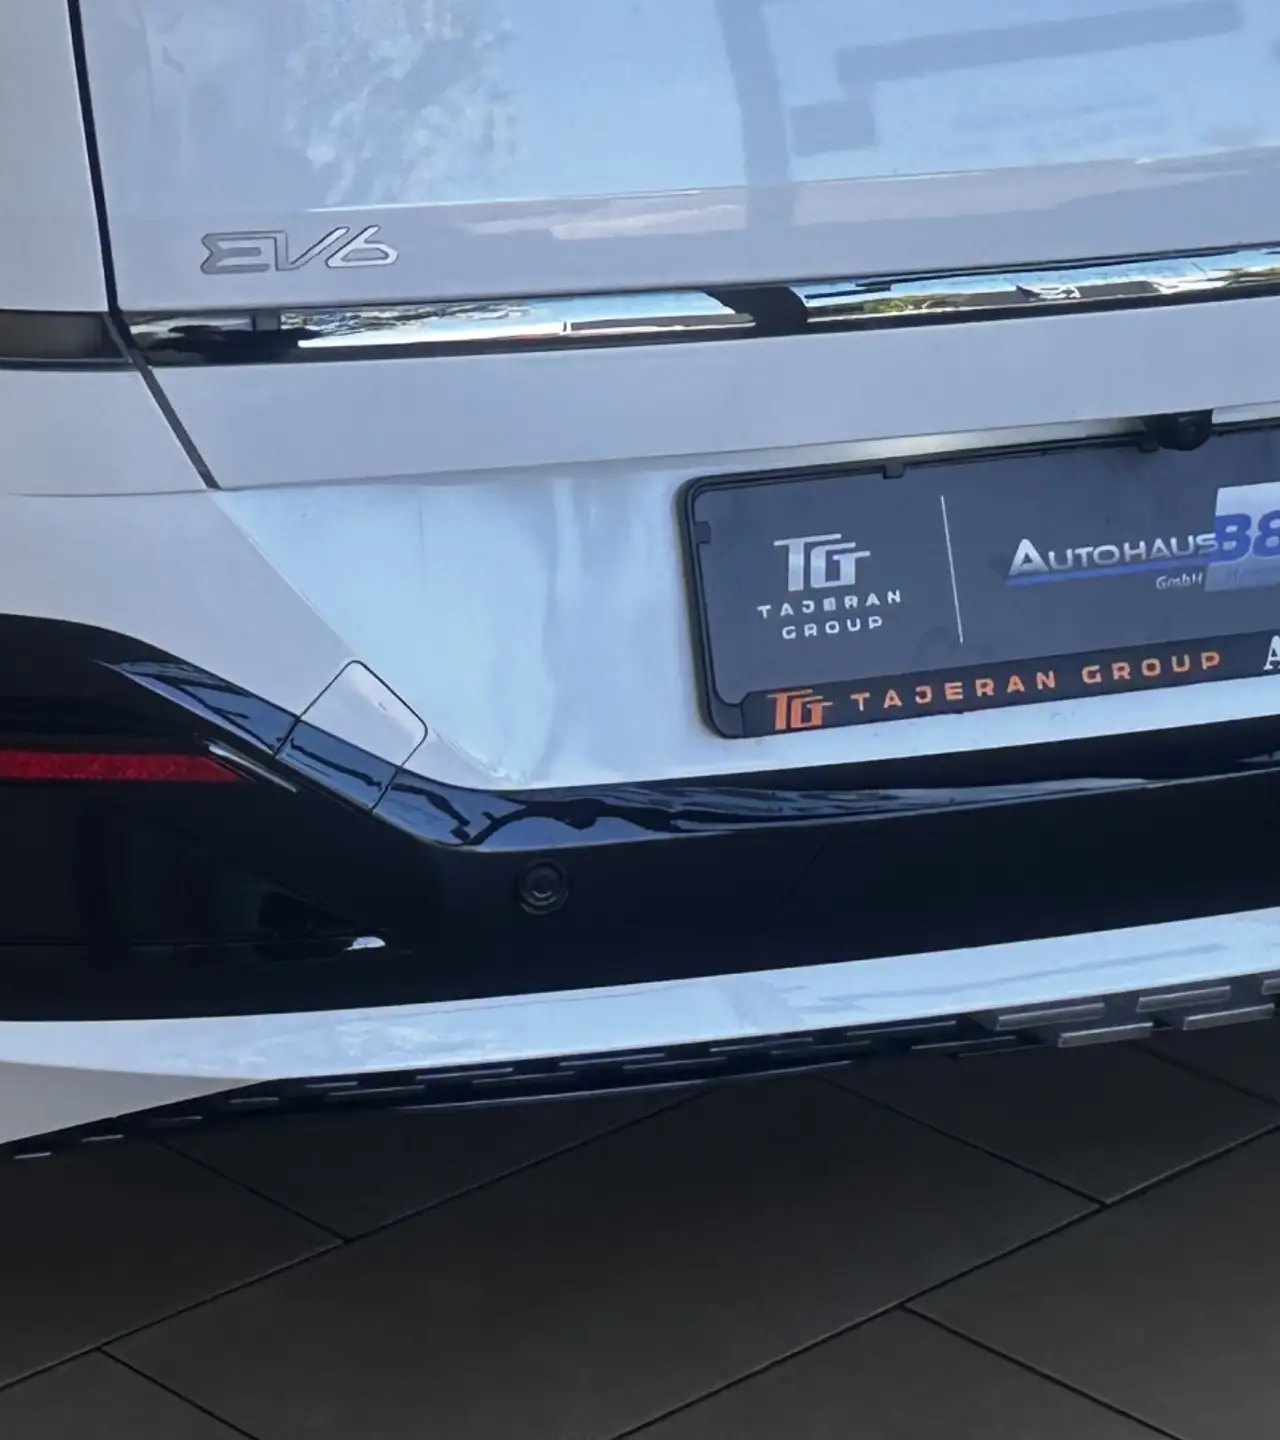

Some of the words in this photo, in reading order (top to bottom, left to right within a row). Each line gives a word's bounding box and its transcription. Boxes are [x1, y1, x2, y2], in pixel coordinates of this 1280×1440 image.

[199, 224, 399, 275] EV6
[773, 532, 871, 592] TG
[1155, 571, 1204, 591] GmbH
[781, 615, 884, 640] GROUP
[765, 687, 833, 731] TG
[850, 671, 1057, 712] TAJERAN
[1081, 651, 1221, 686] GROUP
